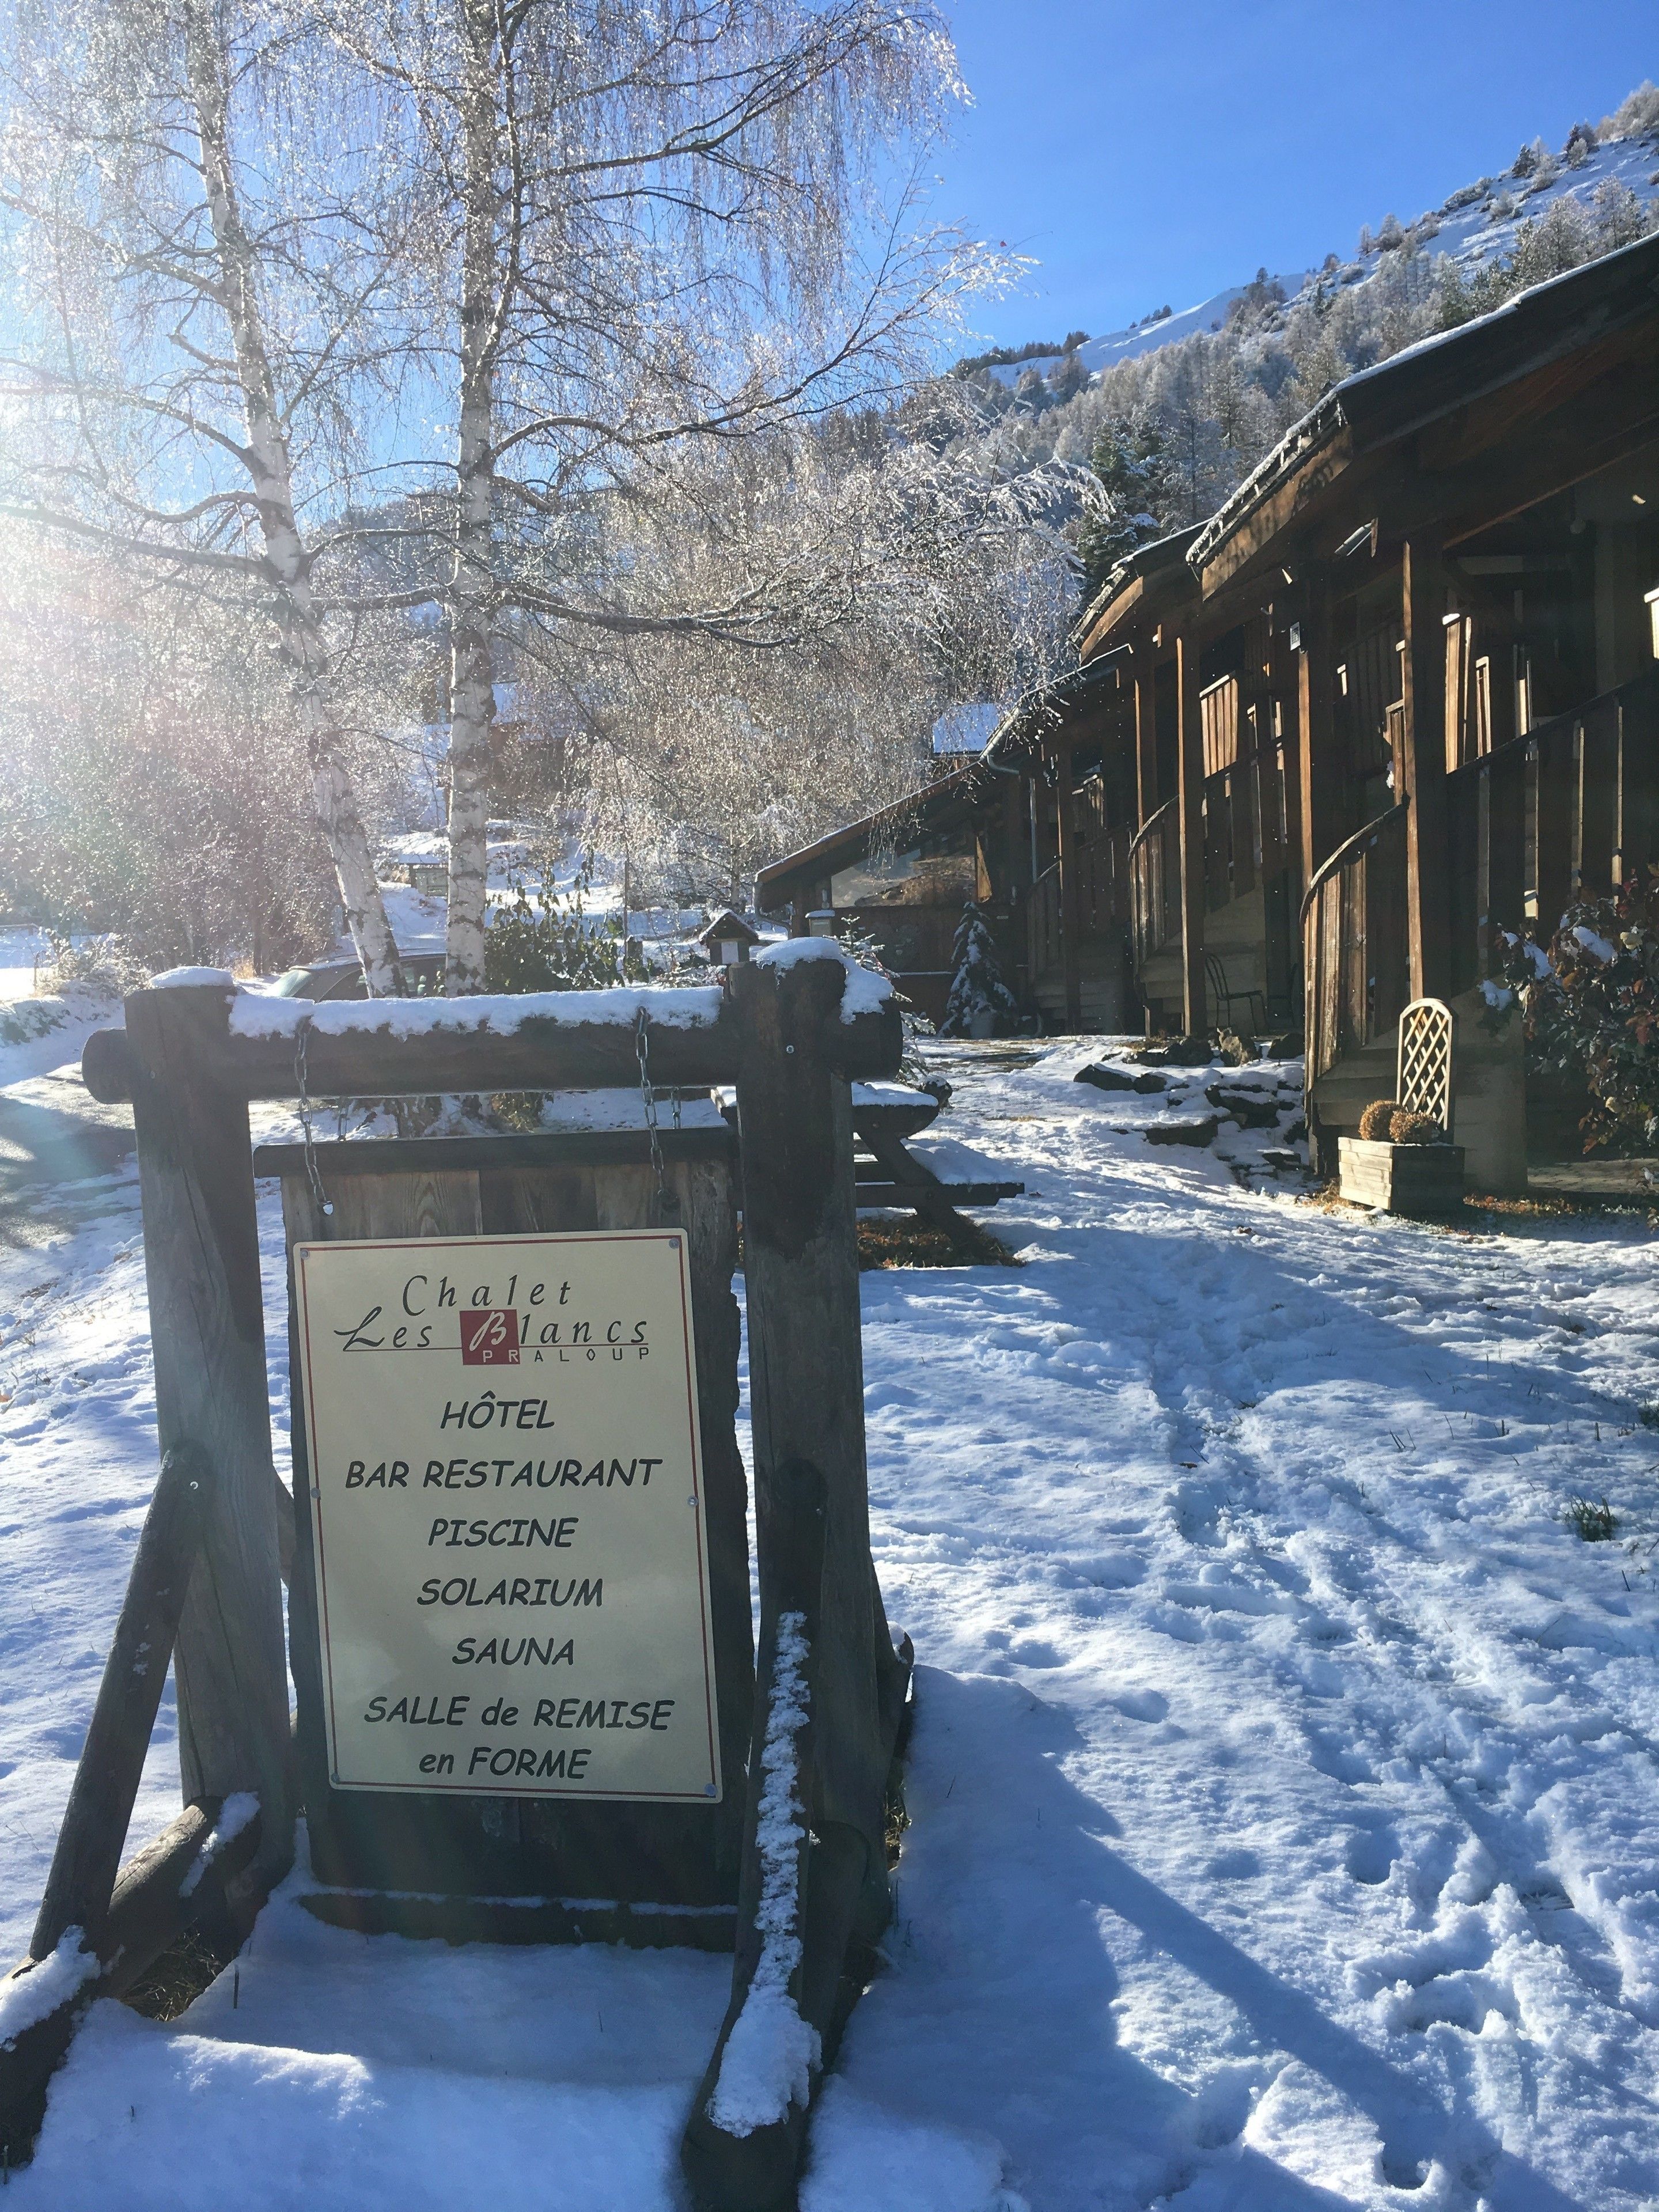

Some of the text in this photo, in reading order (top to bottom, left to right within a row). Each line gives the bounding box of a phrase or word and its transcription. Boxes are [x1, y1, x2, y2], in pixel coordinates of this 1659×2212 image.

[402, 1274, 571, 1316] Chalet
[334, 1306, 647, 1352] Les Blancs
[440, 1390, 555, 1429] HÔTEL
[345, 1459, 663, 1488] BAR RESTAURANT
[427, 1517, 579, 1547] PISCINE
[416, 1578, 603, 1607] SOLARIUM
[452, 1638, 574, 1665] SAUNA
[363, 1696, 675, 1730] SALLE de REMISE
[419, 1747, 592, 1779] en FORME
